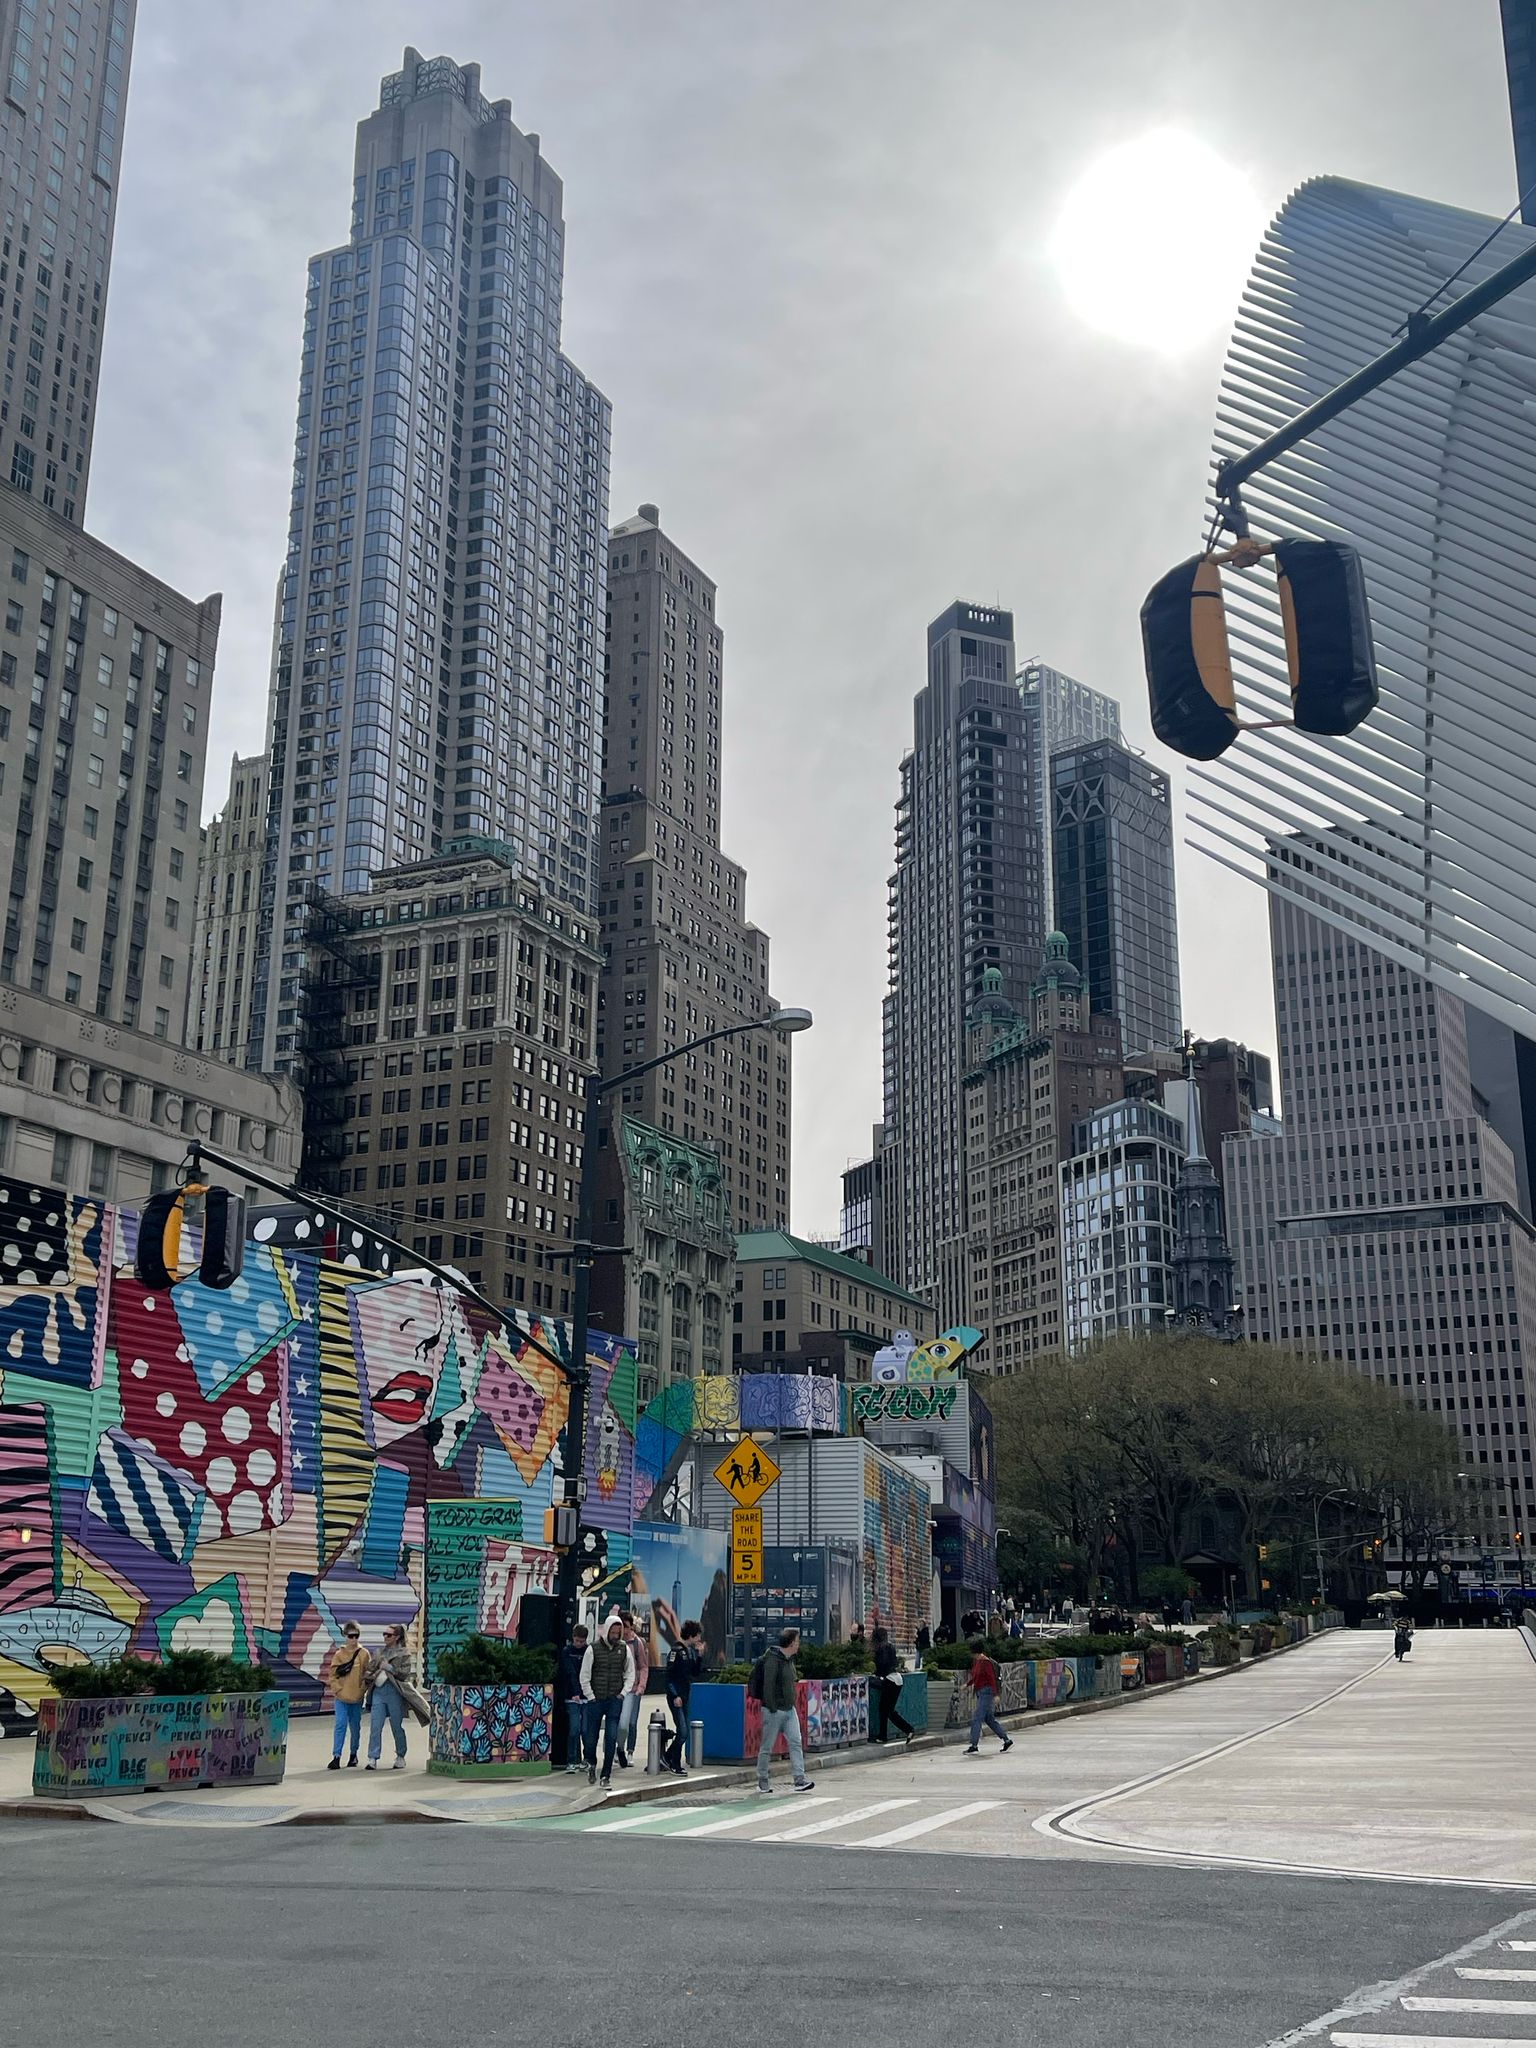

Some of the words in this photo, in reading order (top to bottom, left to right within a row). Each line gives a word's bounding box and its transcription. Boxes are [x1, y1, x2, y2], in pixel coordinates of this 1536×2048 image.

[435, 1508, 477, 1527] TODD
[480, 1508, 522, 1526] GRAY
[735, 1513, 759, 1523] SHARE
[740, 1526, 754, 1535] THE
[737, 1538, 758, 1547] ROAD
[741, 1554, 754, 1571] 5
